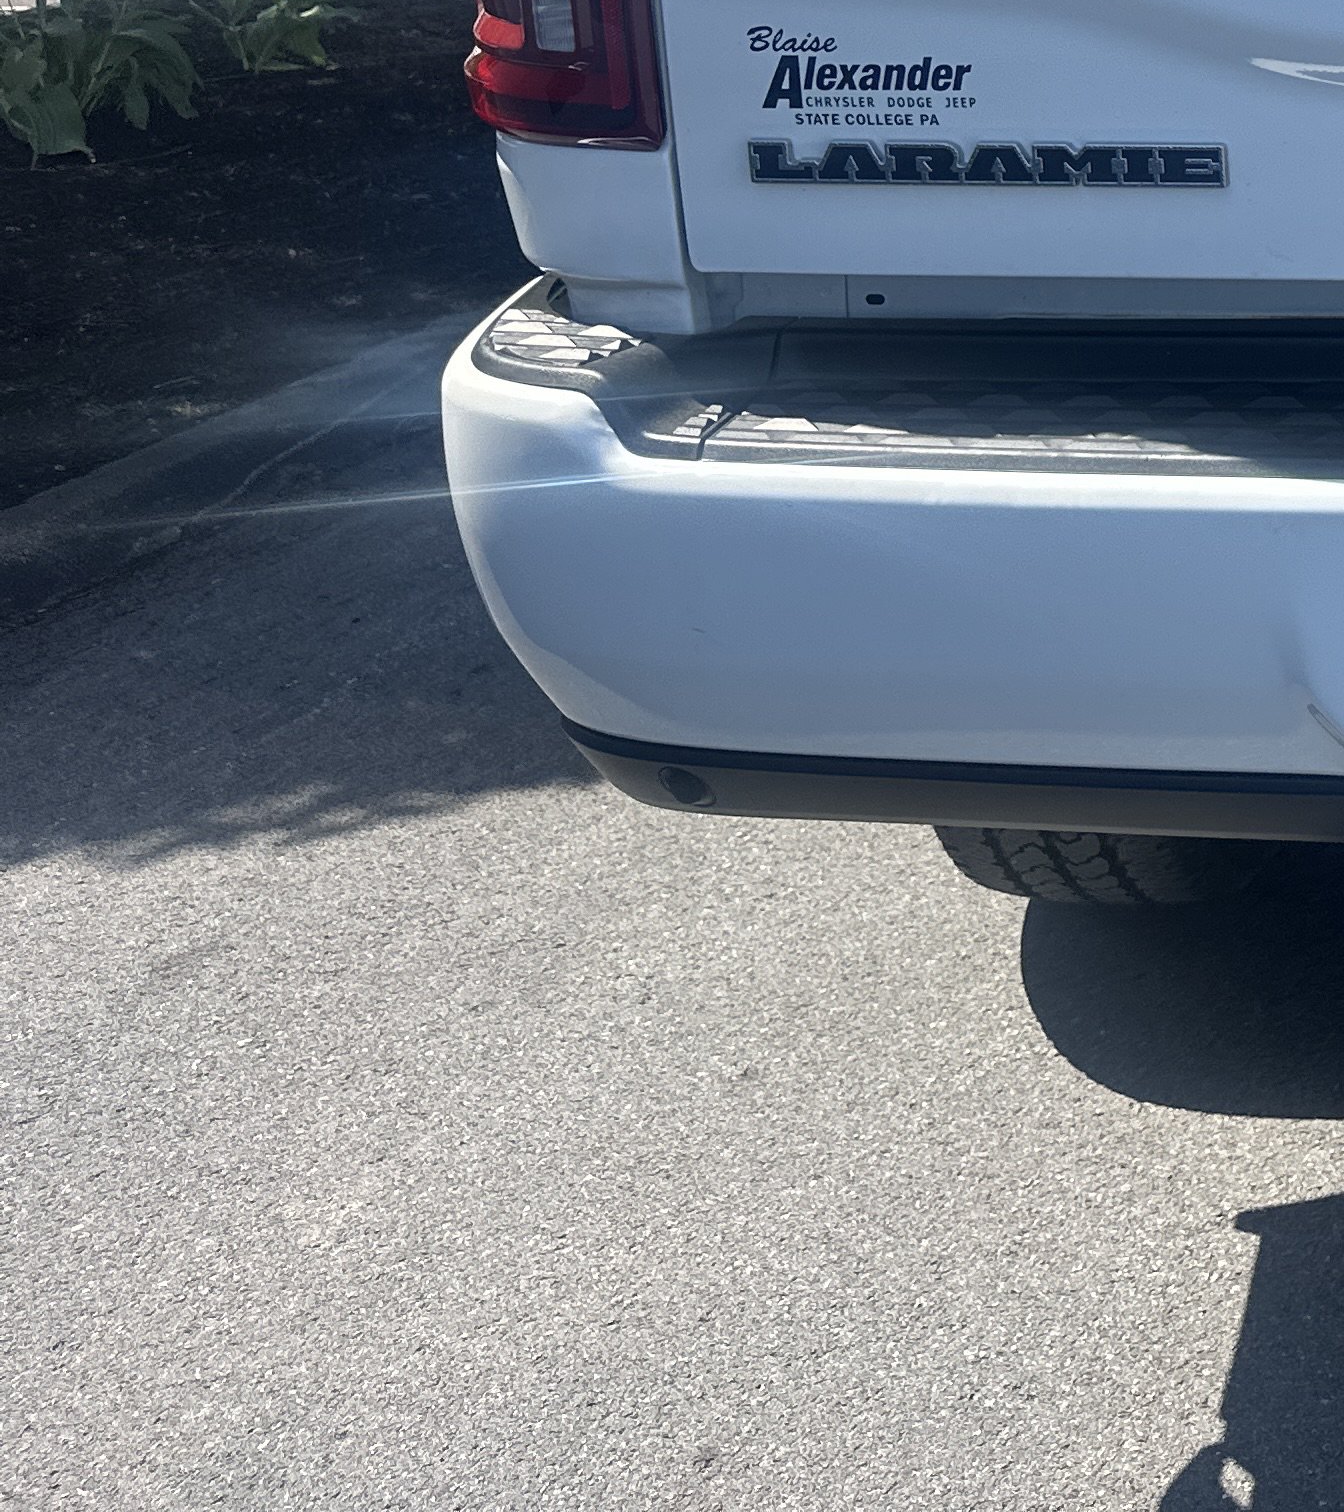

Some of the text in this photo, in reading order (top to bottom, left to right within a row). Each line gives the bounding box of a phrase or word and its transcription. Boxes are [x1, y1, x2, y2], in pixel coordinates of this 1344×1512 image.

[747, 26, 838, 53] Blaise
[762, 54, 972, 109] Alexander
[805, 96, 977, 109] CHRYSLER DODGE JEEP
[794, 113, 940, 126] STATE COLLEGE PA
[748, 139, 1230, 187] LARAMIE
